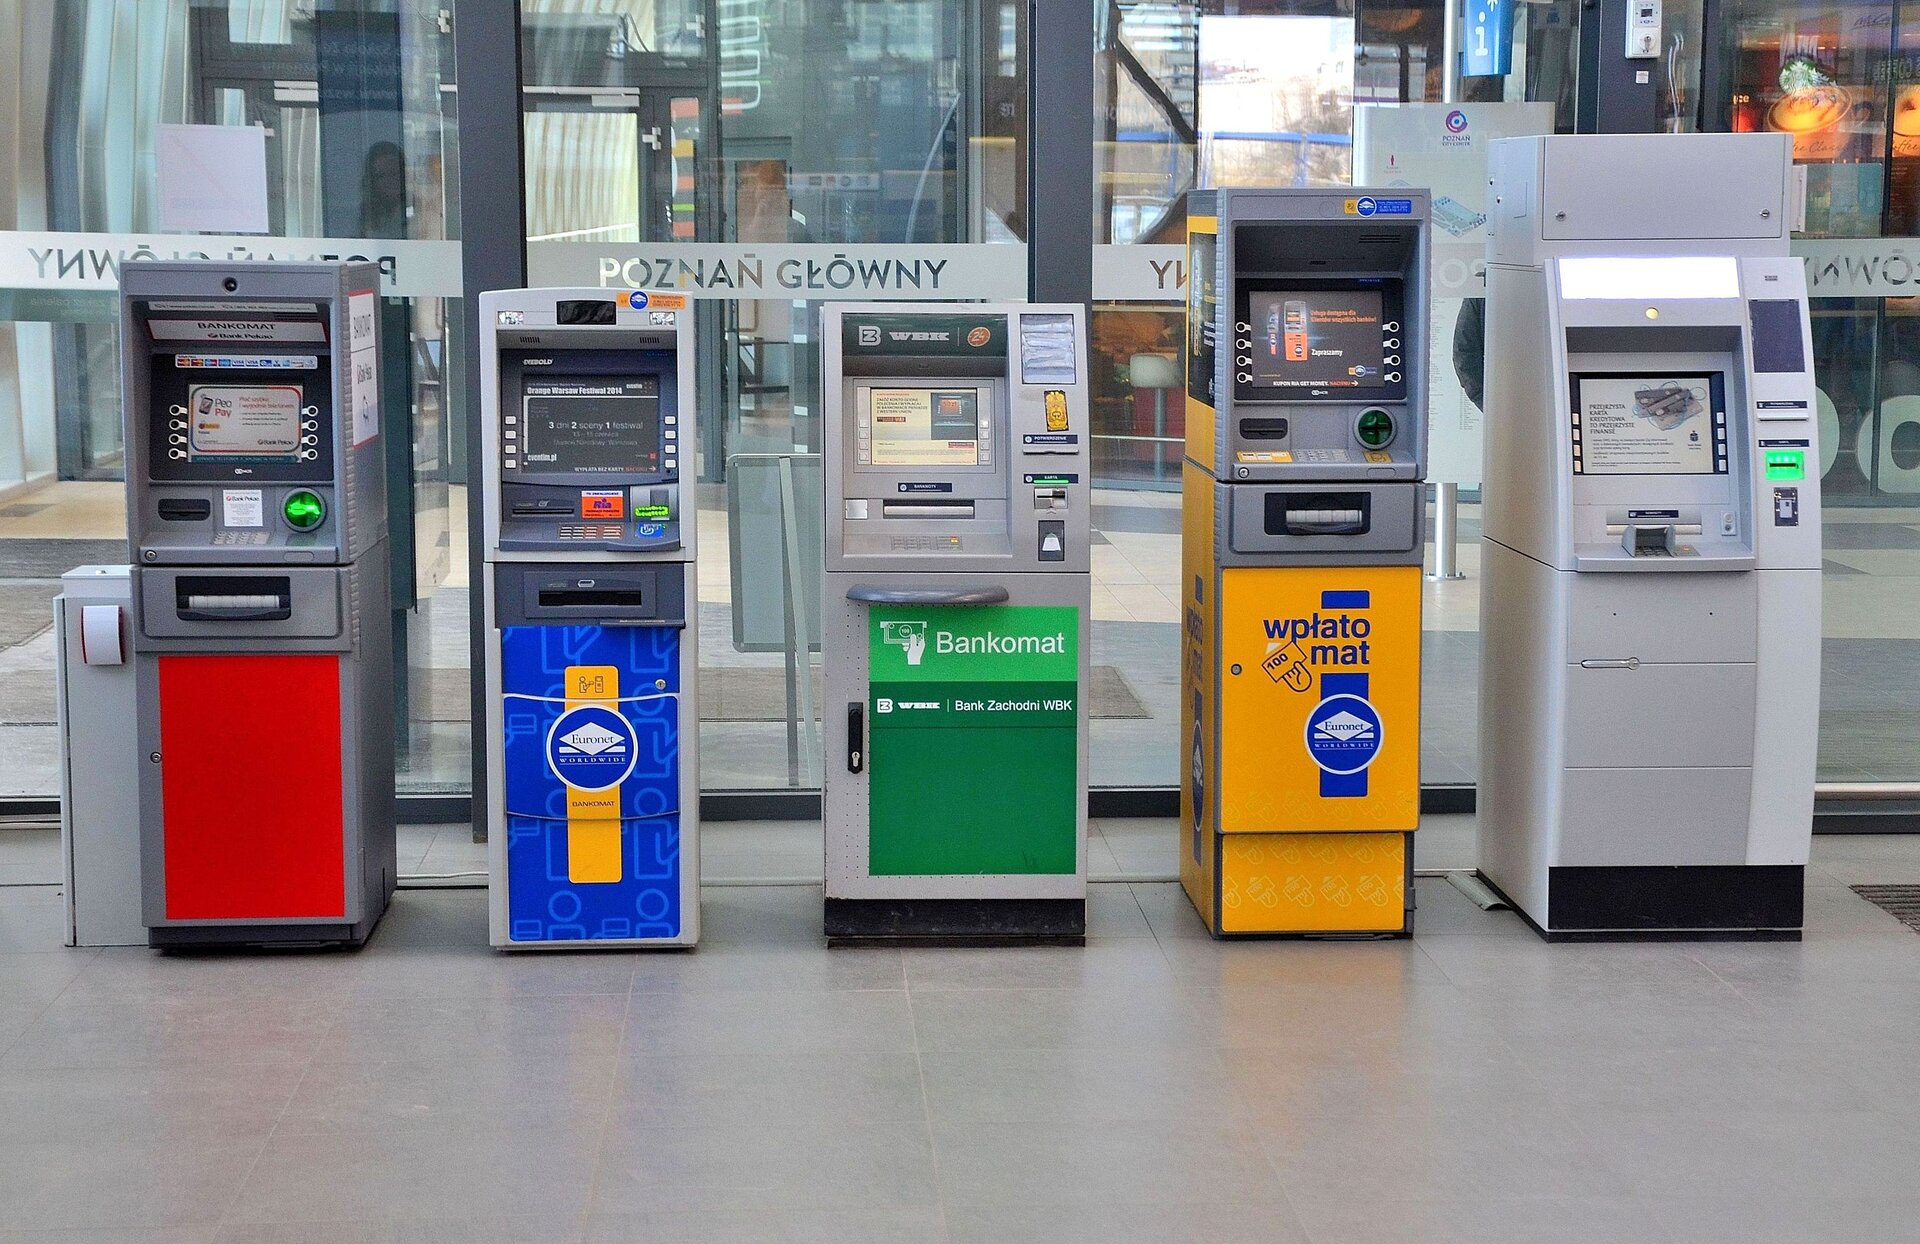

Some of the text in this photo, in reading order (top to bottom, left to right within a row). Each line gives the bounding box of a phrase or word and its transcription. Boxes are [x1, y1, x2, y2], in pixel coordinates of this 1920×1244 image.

[198, 322, 276, 330] BANKOMAT
[889, 331, 950, 342] WBK
[1311, 348, 1343, 357] Zapraszamy
[527, 387, 551, 395] Orange
[215, 399, 233, 408] Peo
[214, 408, 232, 417] Pay
[548, 421, 555, 429] 3
[556, 421, 570, 429] dni
[578, 422, 604, 431] sceny
[612, 421, 644, 429] festiwal
[527, 453, 557, 462] eventim.pl
[1263, 612, 1371, 642] wpłato
[936, 631, 1065, 654] Bankomat
[1311, 640, 1371, 665] mat
[1266, 653, 1289, 670] 100
[955, 700, 984, 711] Bank
[987, 699, 1040, 711] Zachodni
[1043, 700, 1072, 711] WBK
[1324, 720, 1365, 731] Euronet
[571, 733, 615, 745] Euronet
